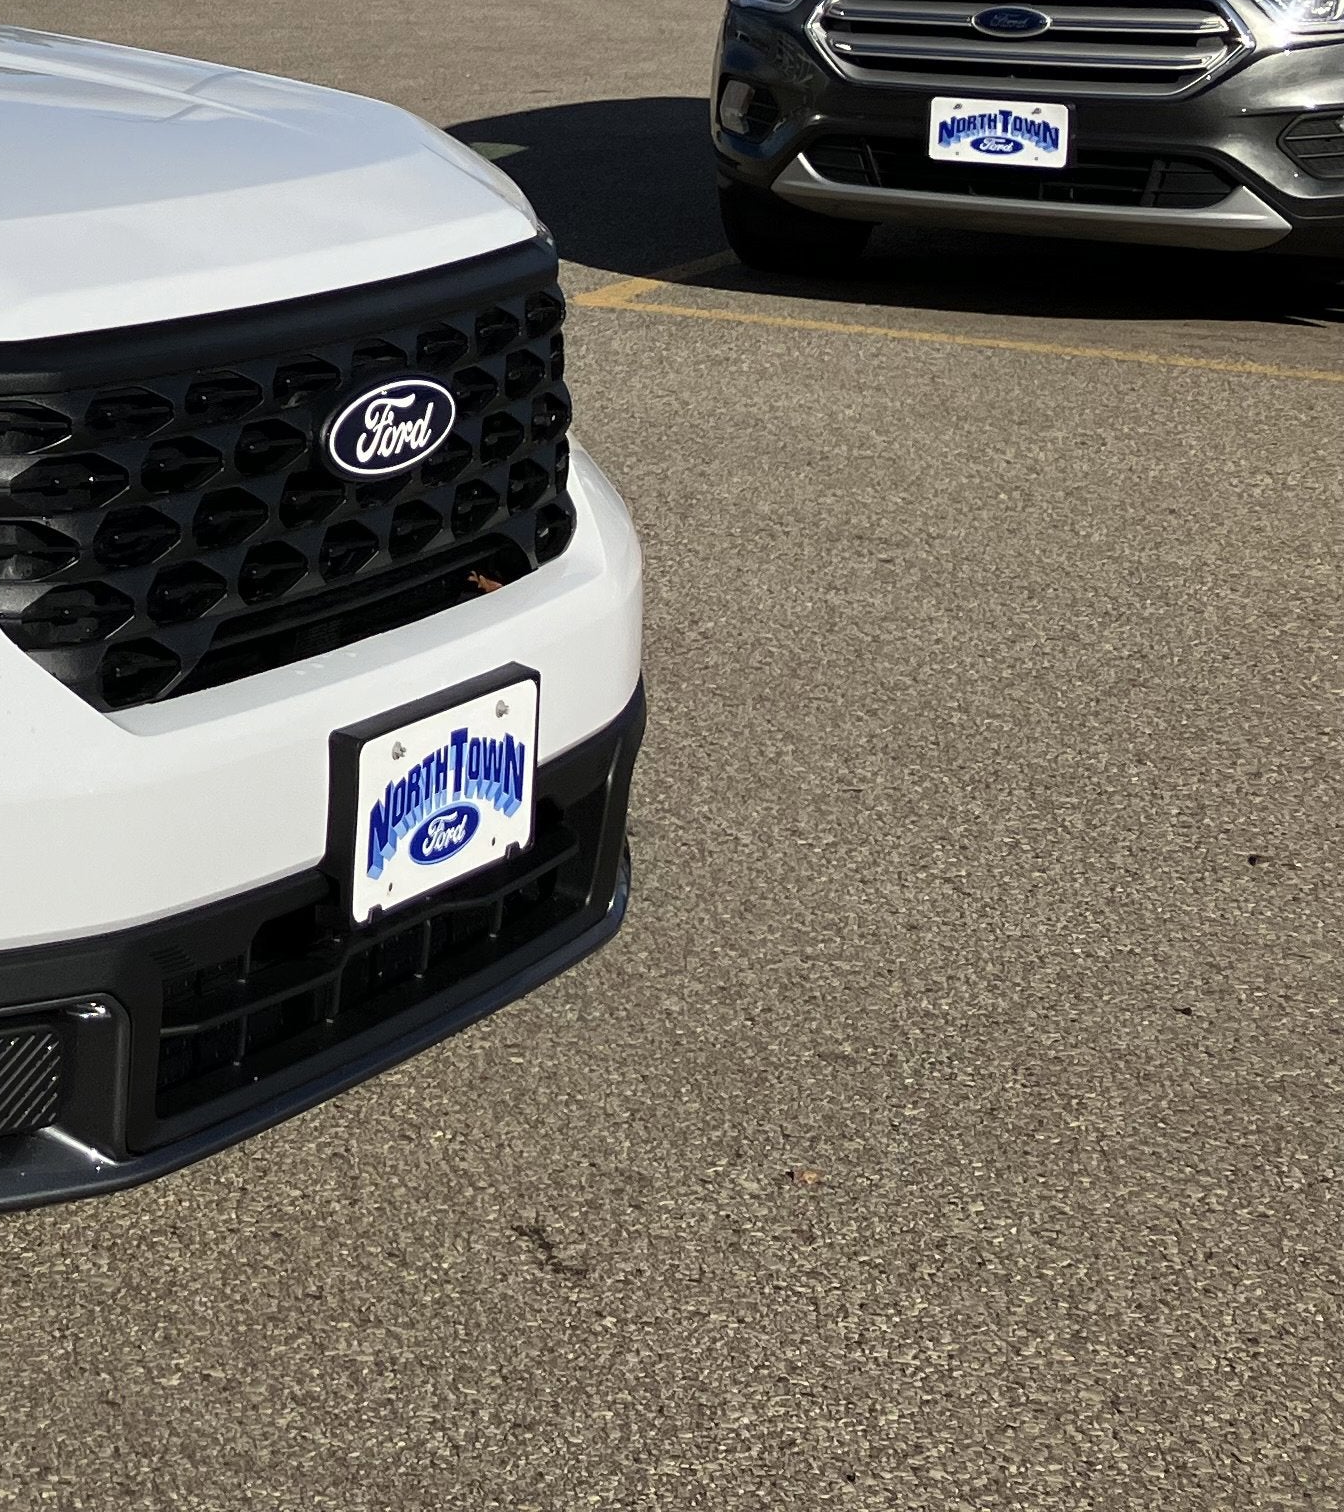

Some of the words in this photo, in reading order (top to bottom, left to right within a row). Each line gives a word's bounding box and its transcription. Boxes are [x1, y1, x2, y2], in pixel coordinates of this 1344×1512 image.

[979, 137, 1015, 152] Ford
[356, 393, 434, 463] Ford
[422, 811, 468, 857] Ford
